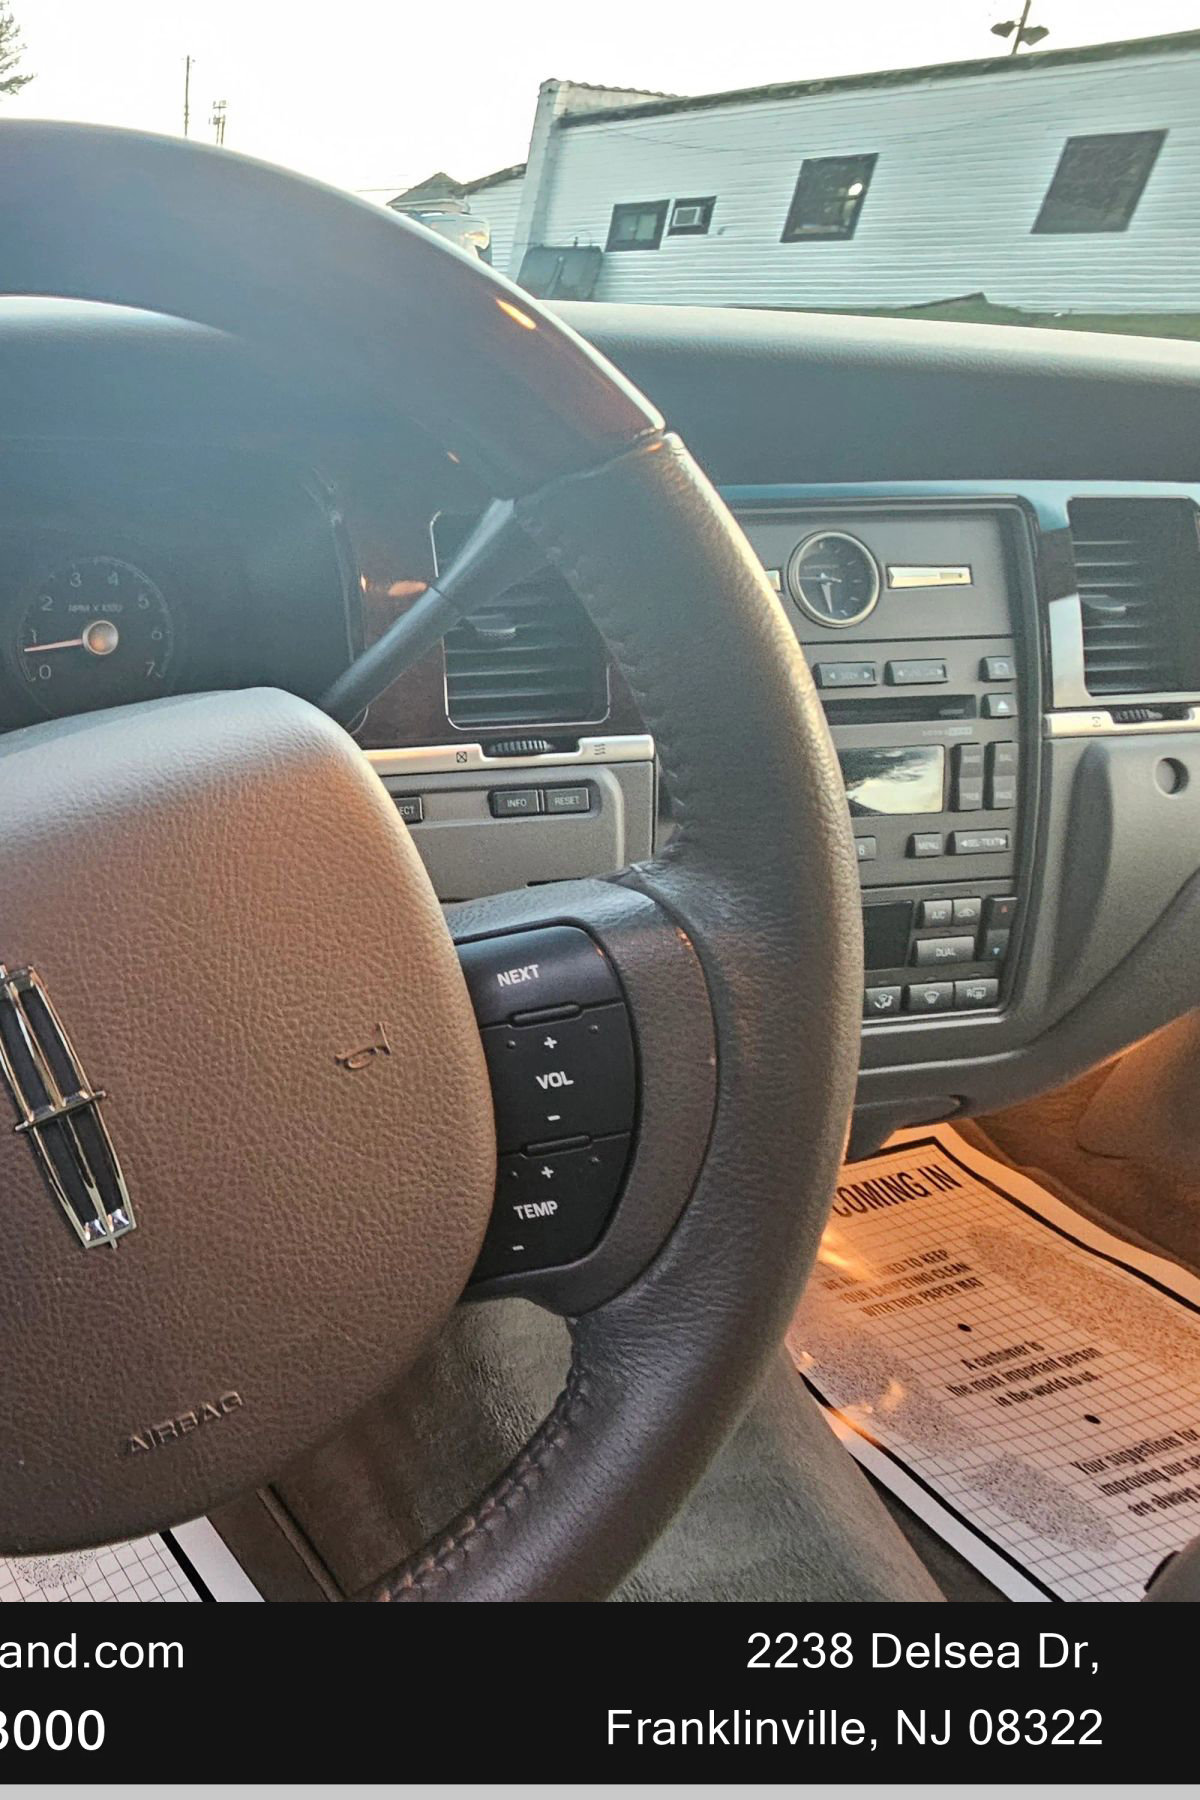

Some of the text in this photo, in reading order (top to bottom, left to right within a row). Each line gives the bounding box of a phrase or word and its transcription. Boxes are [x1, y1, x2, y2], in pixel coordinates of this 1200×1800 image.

[399, 805, 415, 816] ECT
[506, 798, 527, 808] INFO
[554, 795, 580, 806] RESET
[497, 964, 540, 987] NEXT
[536, 1070, 574, 1090] VOL
[917, 1164, 963, 1193] IN
[513, 1200, 558, 1221] TEMP
[919, 1249, 950, 1265] KEEP
[932, 1262, 973, 1280] CLEAN
[895, 1294, 923, 1310] THIS
[918, 1281, 960, 1302] PAPER
[958, 1276, 985, 1291] MAT
[974, 1342, 1027, 1367] customer
[946, 1383, 971, 1398] the
[969, 1374, 1005, 1393] most
[1001, 1357, 1061, 1383] important
[993, 1395, 1012, 1408] in
[1007, 1386, 1035, 1402] the
[1030, 1374, 1069, 1397] world
[128, 1390, 243, 1453] AIRBAG
[1069, 1459, 1111, 1476] Your
[1105, 1436, 1184, 1466] suggestions
[1092, 1469, 1172, 1497] improving
[1161, 1461, 1189, 1477] our
[1128, 1501, 1157, 1517] are
